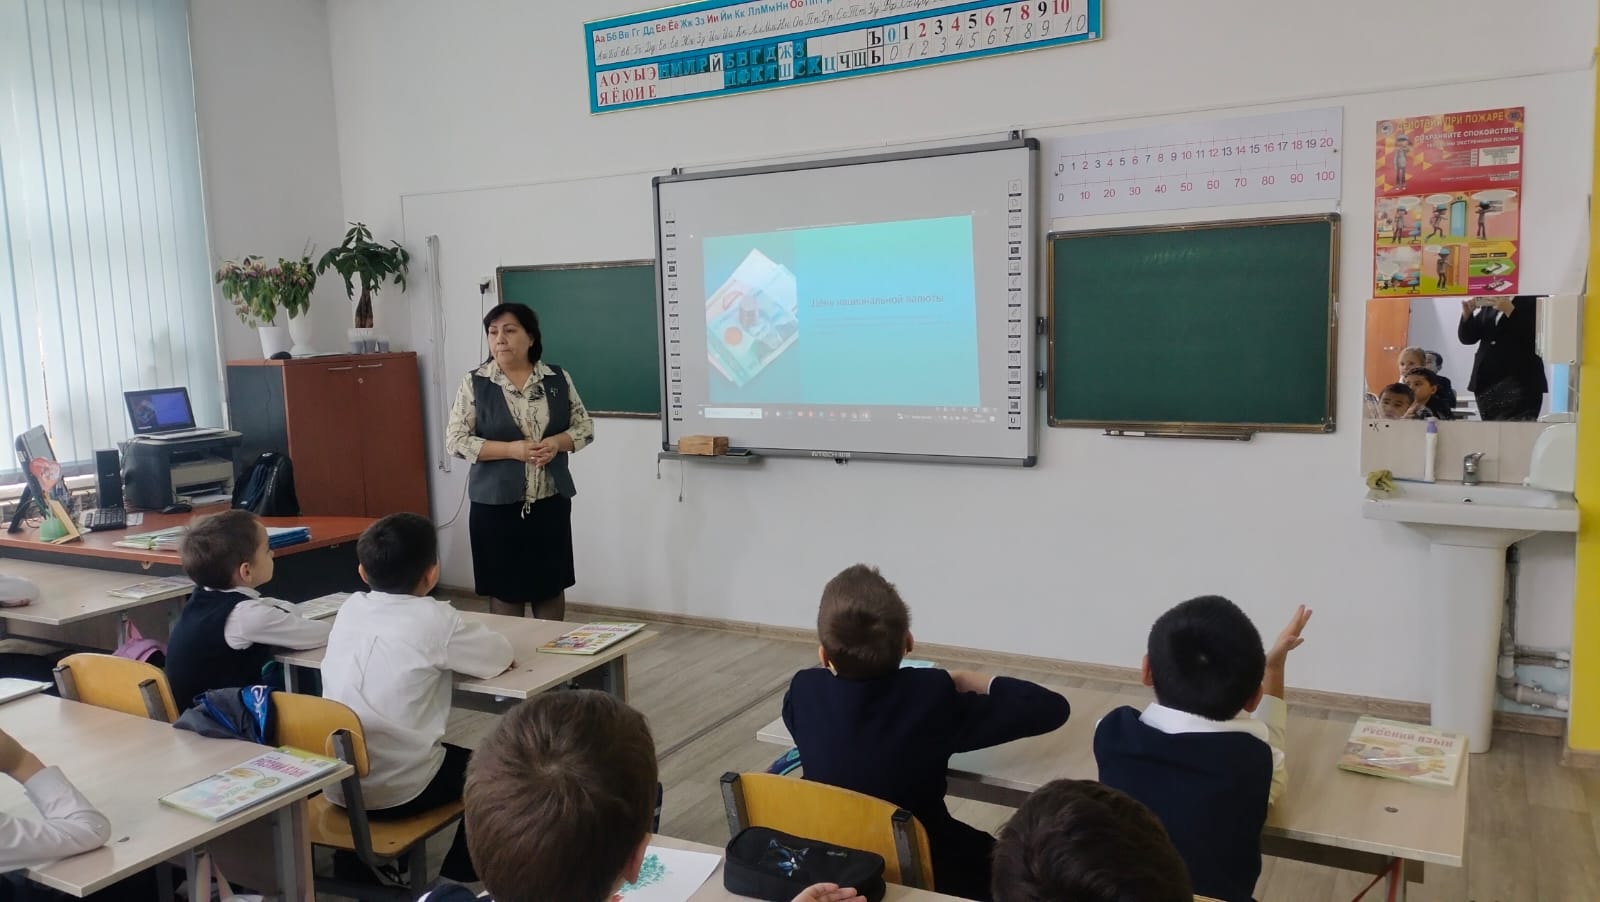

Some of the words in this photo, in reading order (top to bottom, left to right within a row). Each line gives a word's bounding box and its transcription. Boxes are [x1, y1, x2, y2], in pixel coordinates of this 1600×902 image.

[595, 35, 605, 43] Аа
[607, 32, 616, 41] Бб
[619, 30, 629, 39] Вв
[632, 28, 640, 37] Гг
[643, 26, 655, 35] Дд
[656, 24, 666, 33] Ее
[668, 20, 679, 31] Ёё
[681, 18, 692, 28] Жж
[695, 17, 705, 25] Зз
[707, 14, 718, 24] Ии
[735, 10, 745, 18] Кк
[761, 5, 776, 13] Мм
[776, 2, 788, 11] Нн
[790, 0, 804, 8] Оо
[887, 28, 896, 43] 0
[903, 25, 909, 40] 1
[918, 22, 927, 37] 2
[934, 20, 943, 35] 3
[951, 16, 961, 31] 4
[968, 13, 977, 29] 5
[985, 11, 994, 26] 6
[1003, 8, 1012, 23] 7
[1020, 5, 1030, 21] 8
[1038, 1, 1047, 17] 9
[1052, 0, 1069, 15] 10
[890, 45, 898, 61] 0
[908, 43, 914, 58] 1
[920, 40, 929, 56] 2
[939, 37, 947, 53] 3
[955, 34, 964, 49] 4
[969, 32, 979, 48] 5
[988, 28, 997, 45] 6
[1003, 26, 1014, 42] 7
[1024, 23, 1033, 39] 8
[1040, 20, 1050, 36] 9
[1064, 14, 1086, 33] 10
[869, 31, 882, 46] Ъ
[1464, 127, 1519, 137] СПОКОЙСТВИЕ
[1465, 112, 1504, 124] ПОЖАРЕ
[1058, 163, 1064, 174] 0
[1072, 162, 1076, 171] 1
[1082, 160, 1088, 170] 2
[1095, 159, 1101, 169] 3
[1106, 158, 1113, 167] 4
[1119, 157, 1126, 166] 5
[1132, 156, 1138, 165] 6
[1145, 154, 1151, 164] 7
[1157, 153, 1164, 163] 8
[1170, 152, 1178, 161] 9
[1182, 150, 1192, 160] 10
[1196, 149, 1205, 159] 11
[1208, 148, 1218, 158] 12
[1222, 146, 1232, 156] 13
[1235, 145, 1246, 155] 14
[1250, 144, 1260, 154] 15
[1264, 142, 1274, 152] 16
[1278, 141, 1288, 151] 17
[1292, 140, 1303, 150] 18
[1305, 138, 1317, 149] 19
[1319, 137, 1333, 148] 20
[1059, 193, 1064, 202] 0
[1080, 191, 1090, 200] 10
[1103, 188, 1116, 198] 20
[1129, 186, 1141, 196] 30
[1154, 184, 1167, 194] 40
[1180, 182, 1192, 192] 50
[1206, 179, 1220, 190] 60
[1234, 177, 1247, 188] 70
[1261, 175, 1274, 185] 80
[1290, 172, 1303, 183] 90
[1315, 170, 1335, 182] 100
[1362, 726, 1415, 740] РУССКИЙ
[1418, 736, 1454, 748] ЯЗЫК
